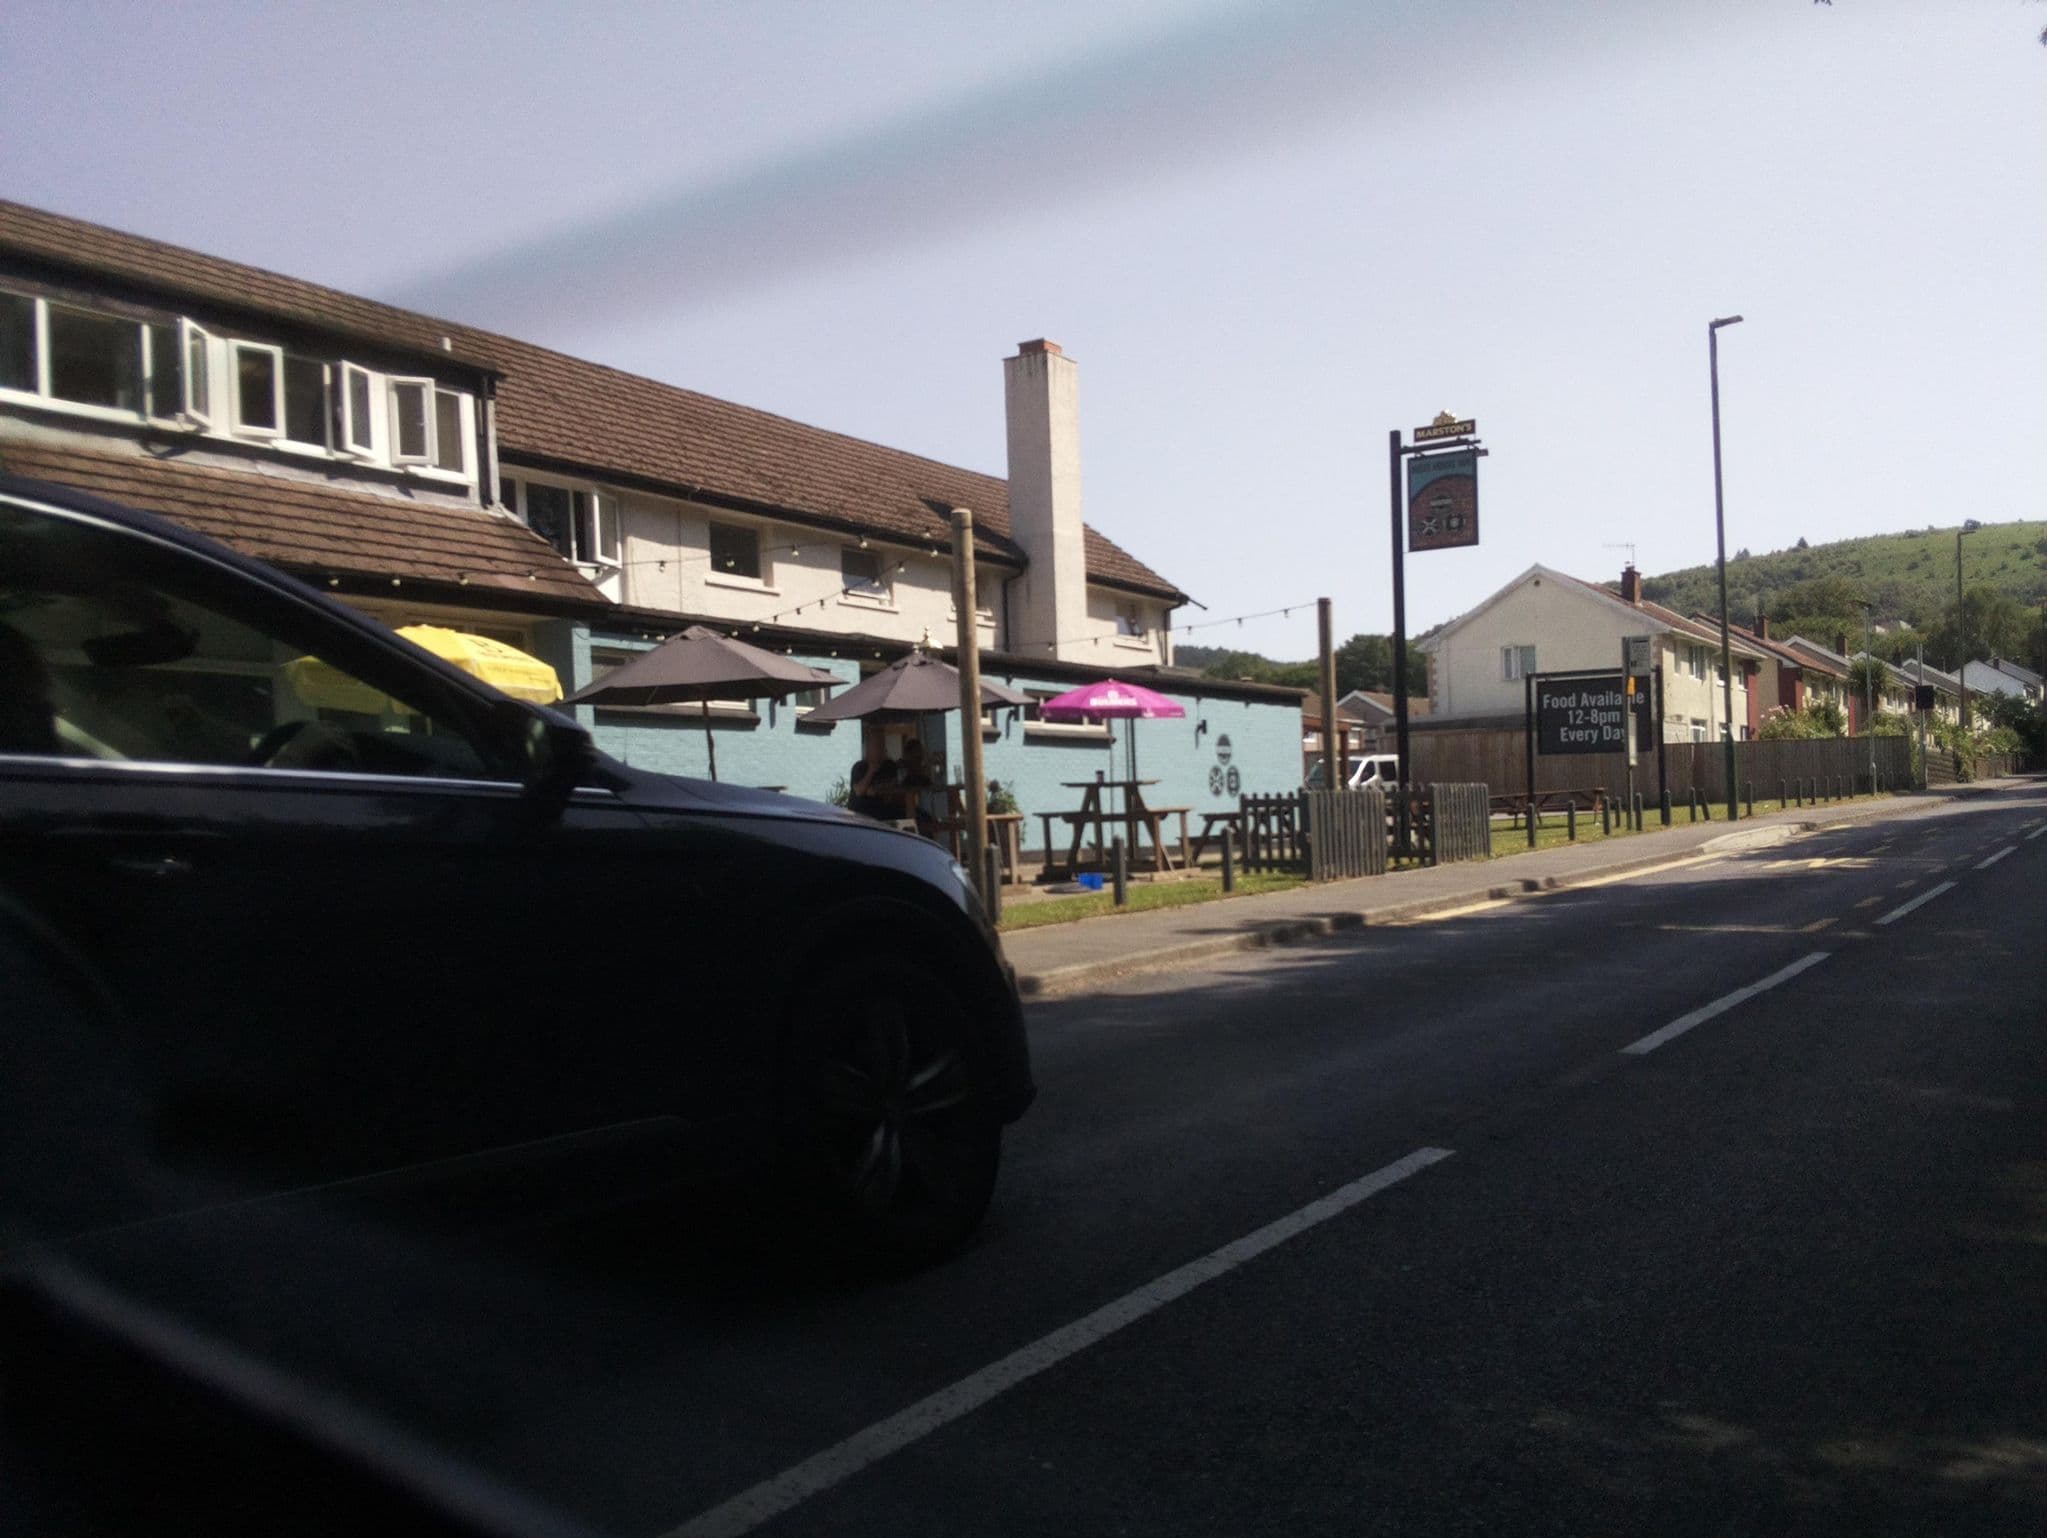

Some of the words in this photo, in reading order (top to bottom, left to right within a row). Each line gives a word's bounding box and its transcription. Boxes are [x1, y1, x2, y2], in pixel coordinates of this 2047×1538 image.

[1416, 423, 1473, 439] MARSTON'S
[1542, 693, 1576, 709] Food
[1580, 691, 1645, 707] Availale
[1567, 709, 1621, 726] 12-8pm
[1559, 727, 1599, 744] Every
